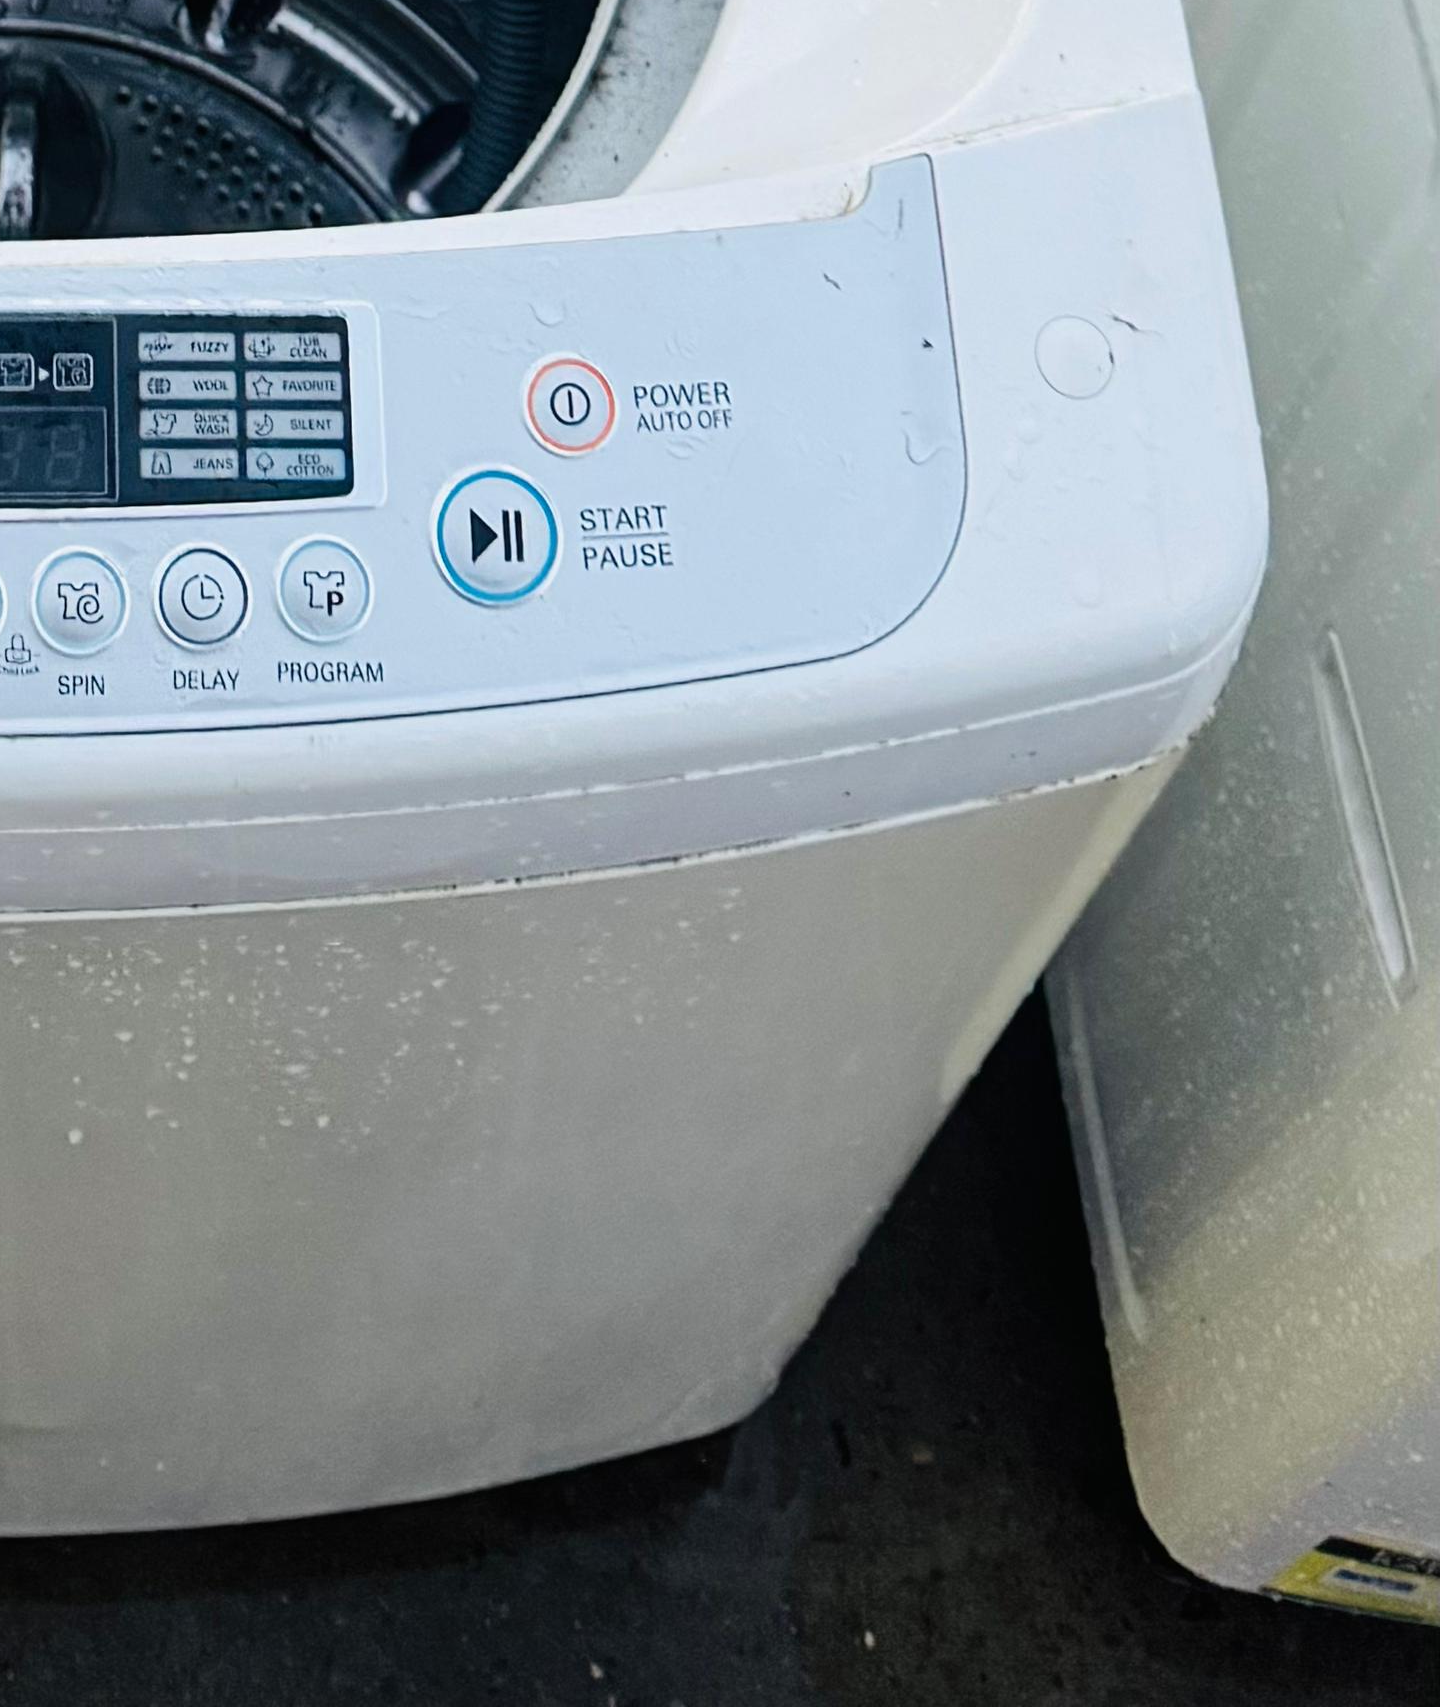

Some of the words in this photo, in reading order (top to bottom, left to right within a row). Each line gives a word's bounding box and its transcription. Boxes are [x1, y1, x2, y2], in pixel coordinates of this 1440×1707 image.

[189, 340, 230, 354] FUZZY
[288, 347, 328, 359] CLEAN
[191, 378, 229, 393] WOOL
[281, 379, 338, 392] FAVORITE
[632, 381, 733, 409] POWER
[193, 411, 230, 424] QUICK
[289, 418, 333, 431] SILENT
[635, 410, 693, 434] AUTO
[696, 407, 735, 431] OFF
[193, 424, 230, 436] WASH
[192, 458, 235, 470] JEANS
[297, 453, 321, 465] ECO
[286, 465, 335, 477] COTTON
[578, 504, 669, 533] START
[582, 542, 675, 571] PAUSE
[277, 659, 385, 685] PROGRAM
[57, 674, 106, 696] SPIN
[172, 669, 241, 692] DELAY
